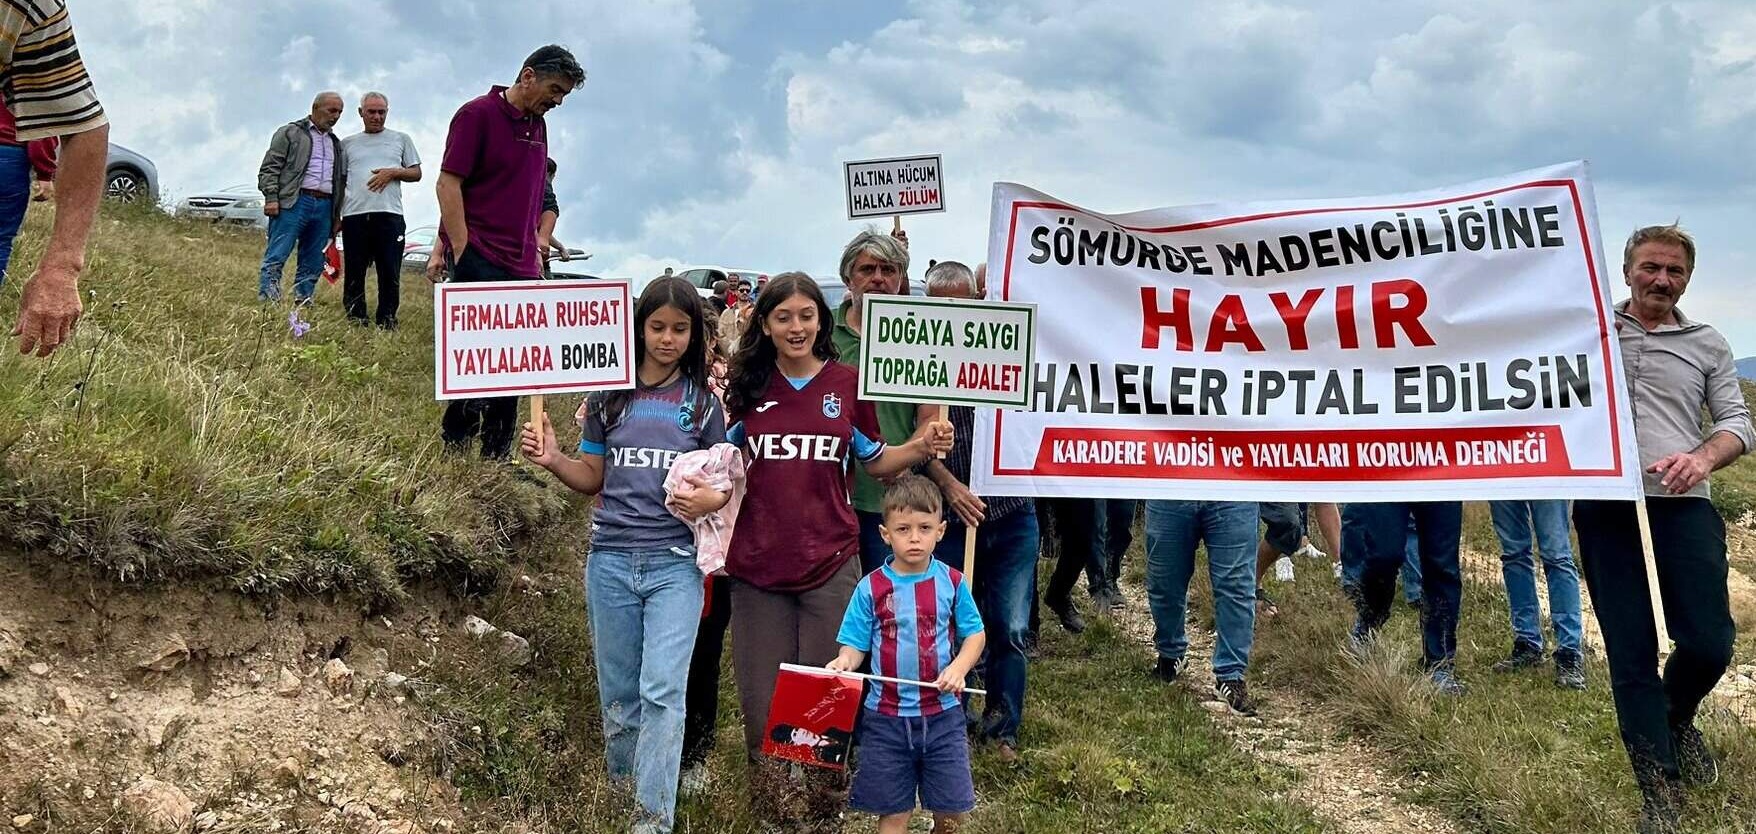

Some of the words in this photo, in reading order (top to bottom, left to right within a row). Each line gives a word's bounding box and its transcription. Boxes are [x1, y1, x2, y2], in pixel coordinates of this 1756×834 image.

[853, 169, 893, 187] ALTINA
[898, 164, 936, 183] HÜCUM
[854, 192, 894, 210] HALKA
[899, 186, 938, 206] ZÜLÜM
[1027, 217, 1214, 276] SÖMÜRGE
[1216, 200, 1564, 277] MADENCİLİĞİNE
[556, 300, 620, 327] RUHSAT
[1141, 278, 1437, 352] HAYIR
[878, 312, 954, 347] DOĞAYA
[963, 321, 1019, 351] SAYGI
[453, 345, 553, 375] YAYLALARA
[561, 342, 619, 370] BOMBA
[873, 354, 949, 388] TOPRAĞA
[956, 362, 1022, 392] ADALET
[1015, 363, 1228, 416] HALELER
[611, 447, 683, 470] VESTE
[748, 434, 841, 463] VESTEL
[1053, 439, 1147, 465] KARADERE
[1153, 436, 1214, 468] VADİSİ
[1221, 448, 1244, 468] ve
[1249, 443, 1350, 469] YAYLALARI
[1357, 441, 1450, 468] KORUMA
[1456, 432, 1547, 466] DERNEĞİ
